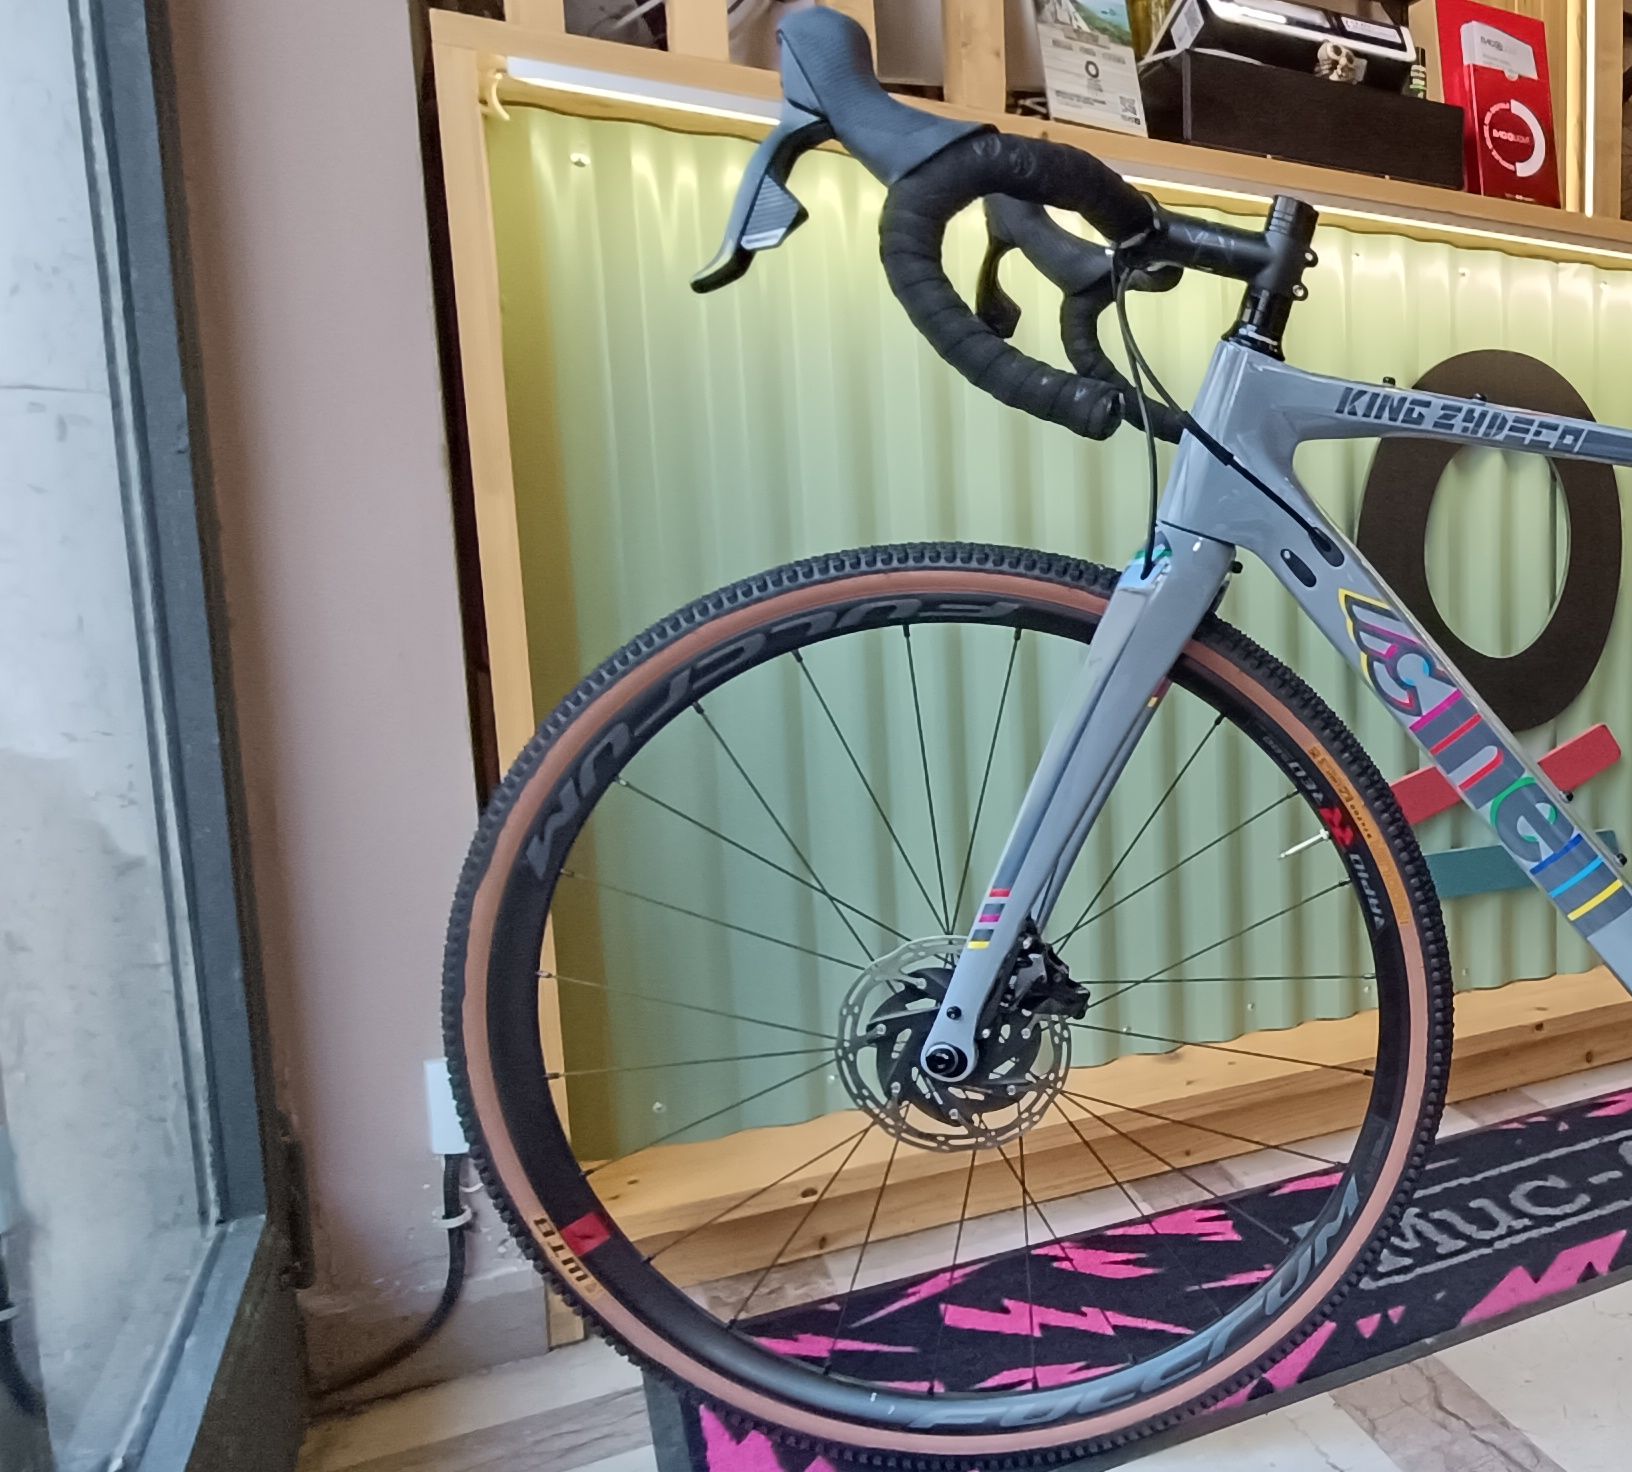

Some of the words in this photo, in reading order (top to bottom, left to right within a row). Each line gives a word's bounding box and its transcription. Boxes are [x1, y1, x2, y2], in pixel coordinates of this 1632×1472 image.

[1334, 386, 1432, 426] KING
[1432, 403, 1590, 453] ZYDECO
[527, 597, 1023, 880] FULCRUM
[1290, 761, 1324, 805] RED
[1350, 853, 1385, 930] RAPID
[908, 1173, 1359, 1428] FULCRUM
